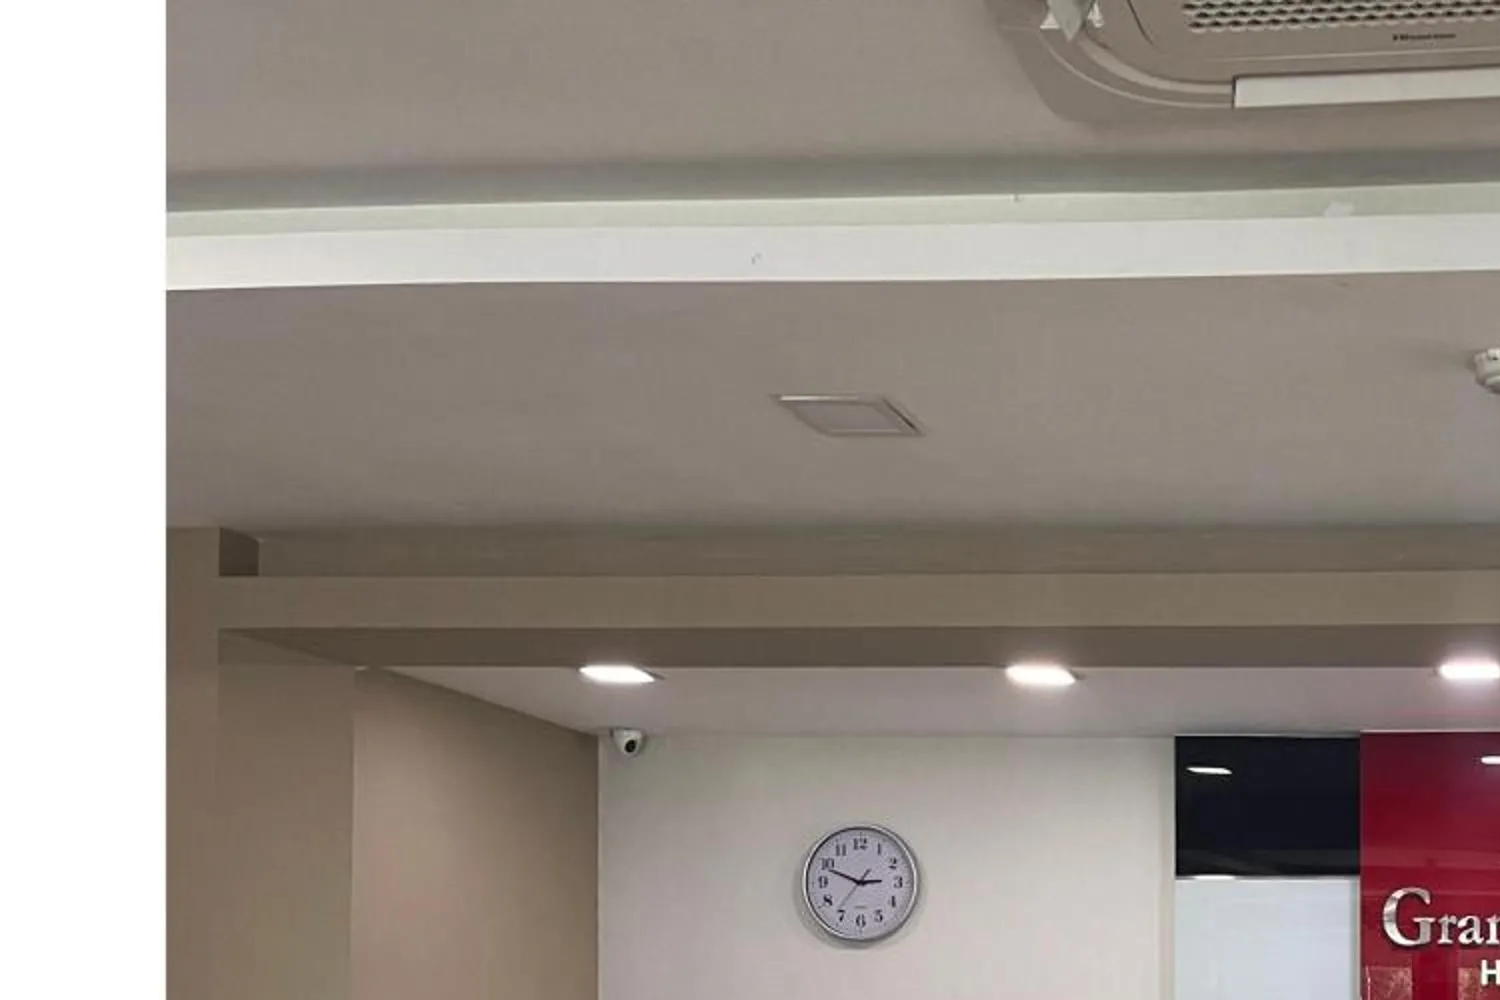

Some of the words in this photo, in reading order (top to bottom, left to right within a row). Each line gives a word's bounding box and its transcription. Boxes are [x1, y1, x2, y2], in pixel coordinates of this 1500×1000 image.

[835, 843, 847, 856] 11
[852, 837, 868, 851] 12
[820, 857, 835, 870] 10
[888, 857, 897, 870] 2
[818, 875, 829, 889] 9
[893, 875, 903, 888] 3
[823, 894, 833, 906] 8
[889, 895, 896, 908] 4
[837, 909, 846, 922] 7
[855, 914, 866, 928] 6
[874, 909, 884, 922] 5
